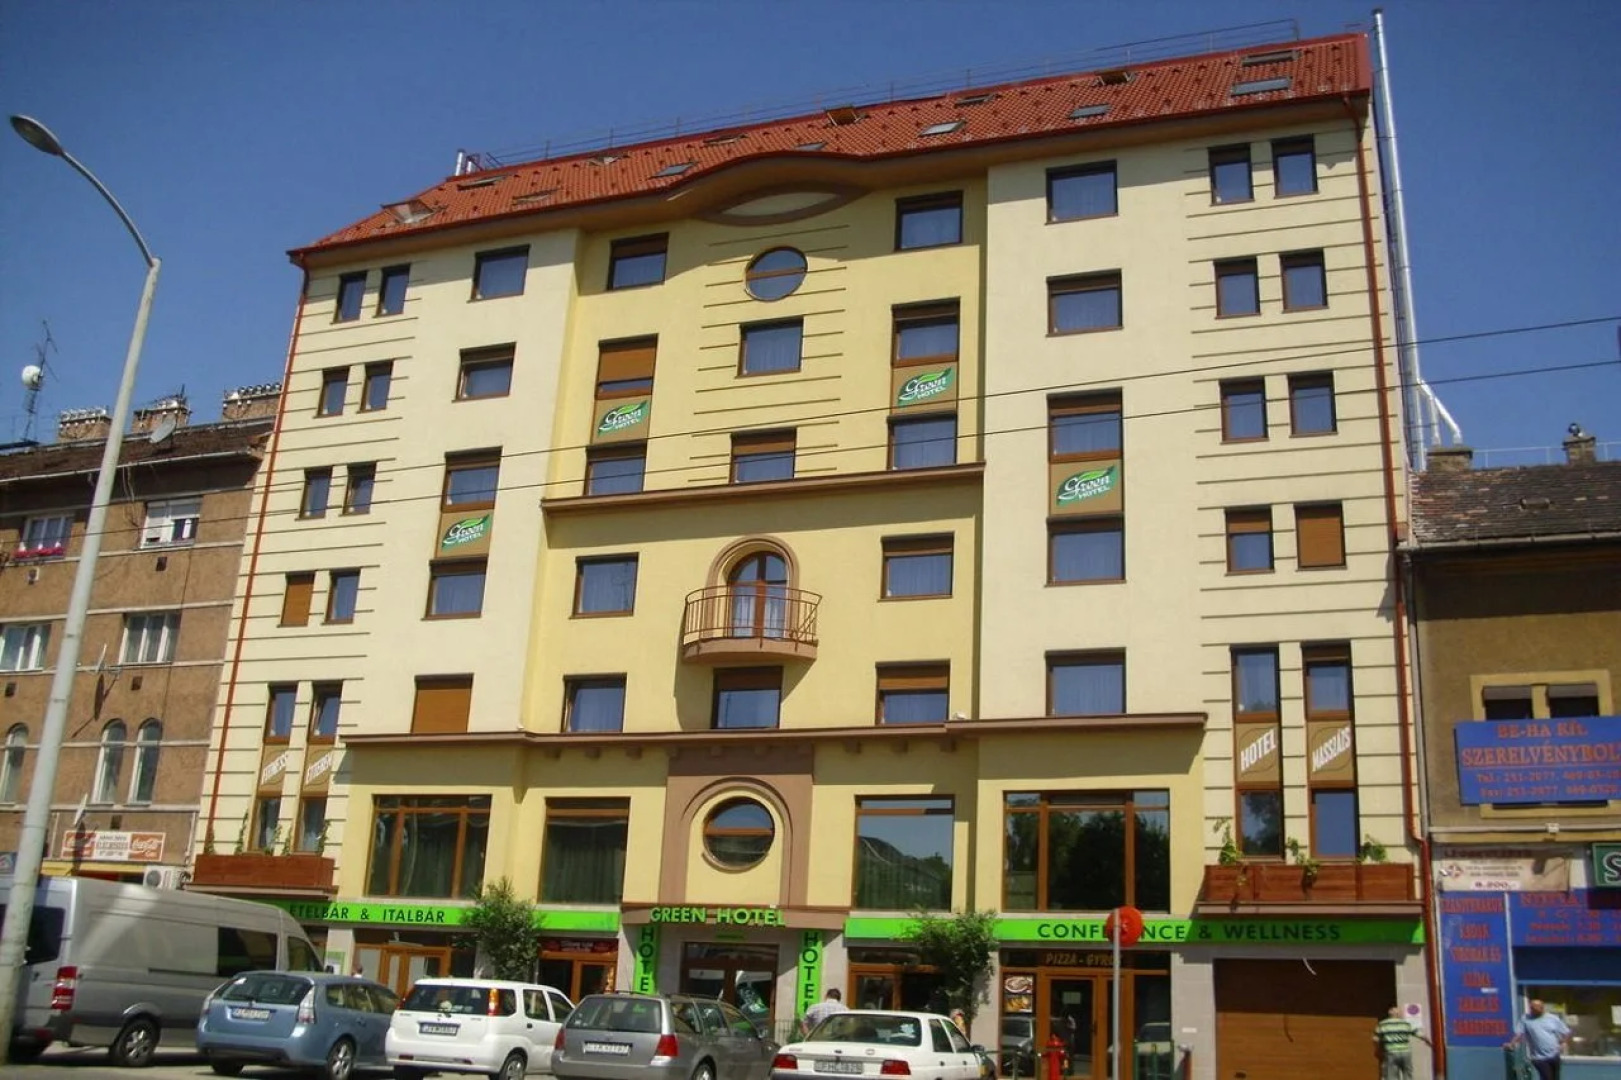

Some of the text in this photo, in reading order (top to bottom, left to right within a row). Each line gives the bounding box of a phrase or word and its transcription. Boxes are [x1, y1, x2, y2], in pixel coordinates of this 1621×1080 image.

[899, 377, 946, 400] Green
[599, 408, 641, 430] Green
[1058, 476, 1109, 500] Green
[1079, 485, 1109, 499] HOTEL
[443, 522, 483, 544] Green
[1241, 728, 1276, 772] HOTEL
[360, 908, 369, 920] &
[383, 906, 445, 923] ITALBÁR
[650, 907, 785, 926] GREEN HOTEL
[1037, 923, 1341, 940] CONFNCE & WELLNESS
[639, 927, 654, 991] HOTE
[1045, 953, 1076, 967] PIZZA
